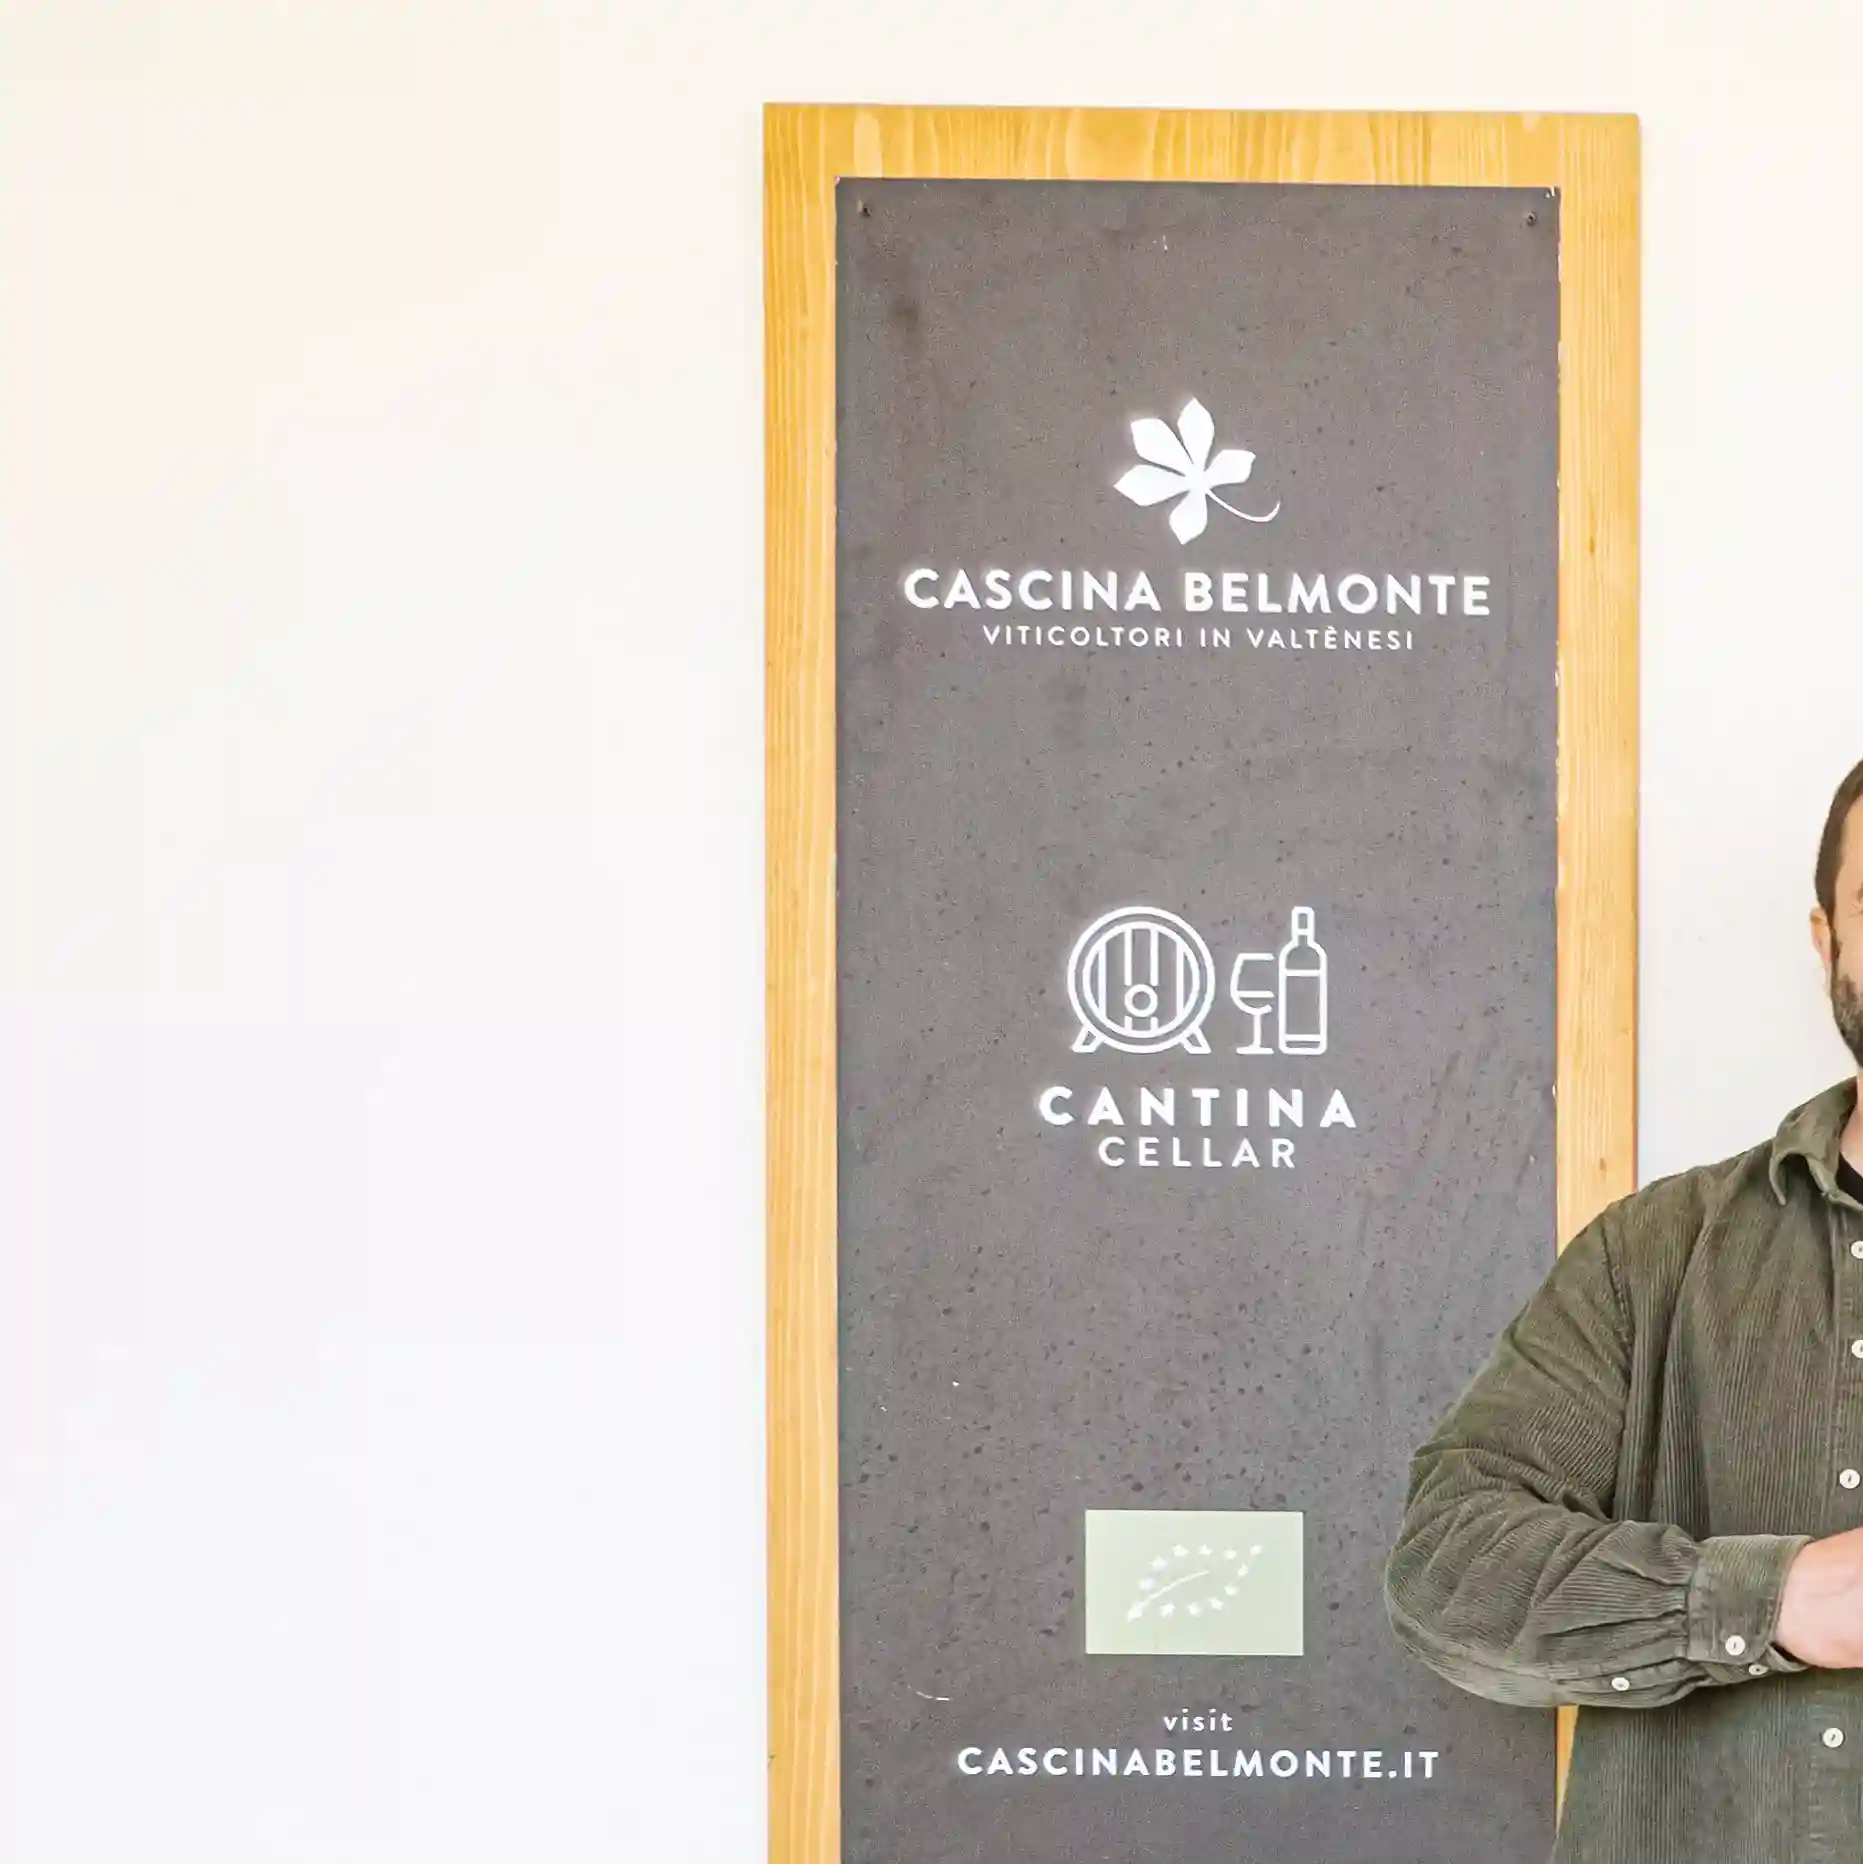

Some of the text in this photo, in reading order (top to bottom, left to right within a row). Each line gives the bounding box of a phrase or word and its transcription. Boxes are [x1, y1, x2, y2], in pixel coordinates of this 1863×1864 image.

[903, 567, 1491, 617] CASCINA BELMONTE
[981, 624, 1413, 651] VITICOLTORI IN VALTÈNESI
[1037, 1084, 1358, 1129] CANTINA
[1097, 1135, 1296, 1169] CELLAR
[1162, 1707, 1234, 1733] visit
[956, 1745, 1440, 1780] CASCINABELMONTE.IT
